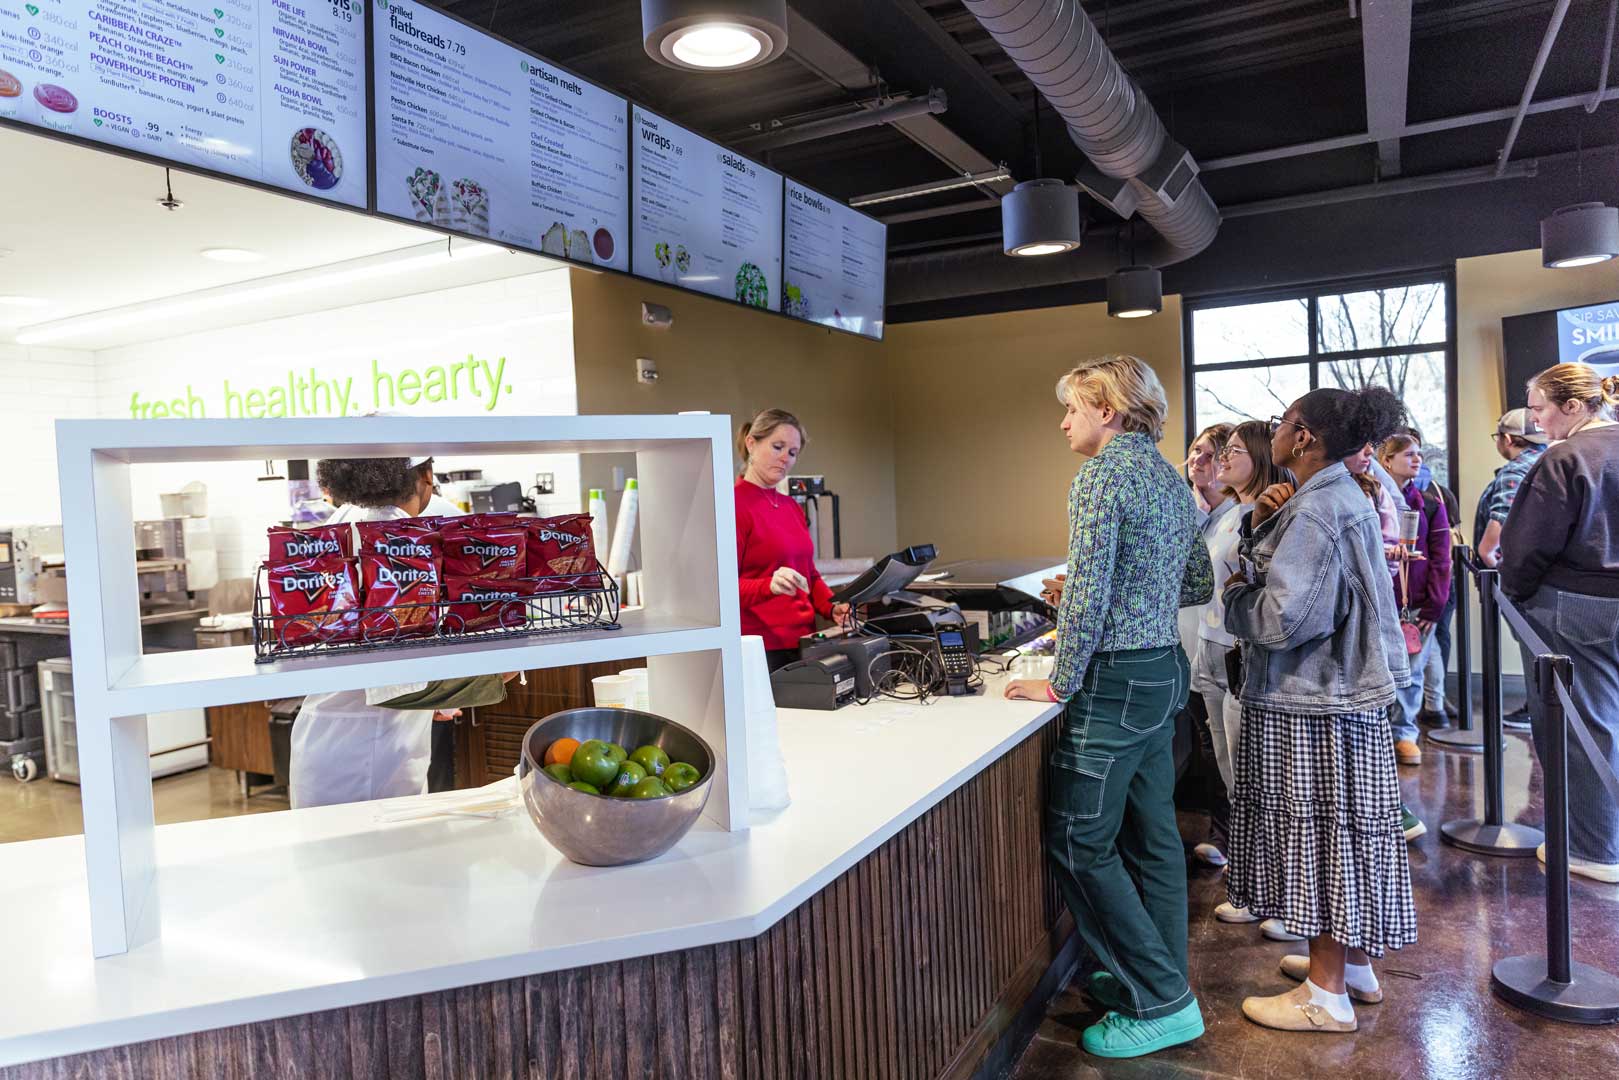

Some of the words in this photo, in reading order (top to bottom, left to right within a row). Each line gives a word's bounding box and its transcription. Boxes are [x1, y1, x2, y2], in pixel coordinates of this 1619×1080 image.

[292, 6, 306, 18] LIFE
[332, 6, 352, 23] 8.19
[389, 4, 413, 21] grilled
[88, 10, 143, 37] CARIBBEAN
[272, 26, 307, 46] NIRVANA
[307, 40, 329, 55] BOWL
[389, 14, 445, 50] flatbreads
[447, 39, 467, 56] 7.79
[89, 31, 122, 49] PEACH
[123, 43, 138, 54] ON
[139, 48, 154, 61] THE
[90, 52, 158, 81] POWERHOUSE
[159, 74, 195, 93] PROTEIN
[273, 55, 290, 68] SUN
[290, 60, 317, 77] POWER
[529, 64, 559, 86] artisan
[560, 79, 583, 97] melts
[274, 83, 301, 99] ALOHA
[301, 92, 323, 106] BOWL
[390, 96, 406, 107] Pesto
[406, 100, 428, 114] Chicken
[93, 107, 133, 126] BOOSTS
[391, 113, 408, 127] Santa
[641, 127, 671, 151] wraps
[722, 154, 746, 173] salads
[790, 186, 803, 202] rice
[803, 192, 823, 212] bowls
[129, 385, 206, 419] fresh
[372, 353, 512, 411] hearty.
[539, 529, 589, 545] Doritos
[286, 539, 340, 557] Doritos
[374, 540, 432, 557] Doritos
[463, 544, 517, 556] Doritos
[283, 571, 345, 592] Doritos
[379, 566, 438, 583] Doritos
